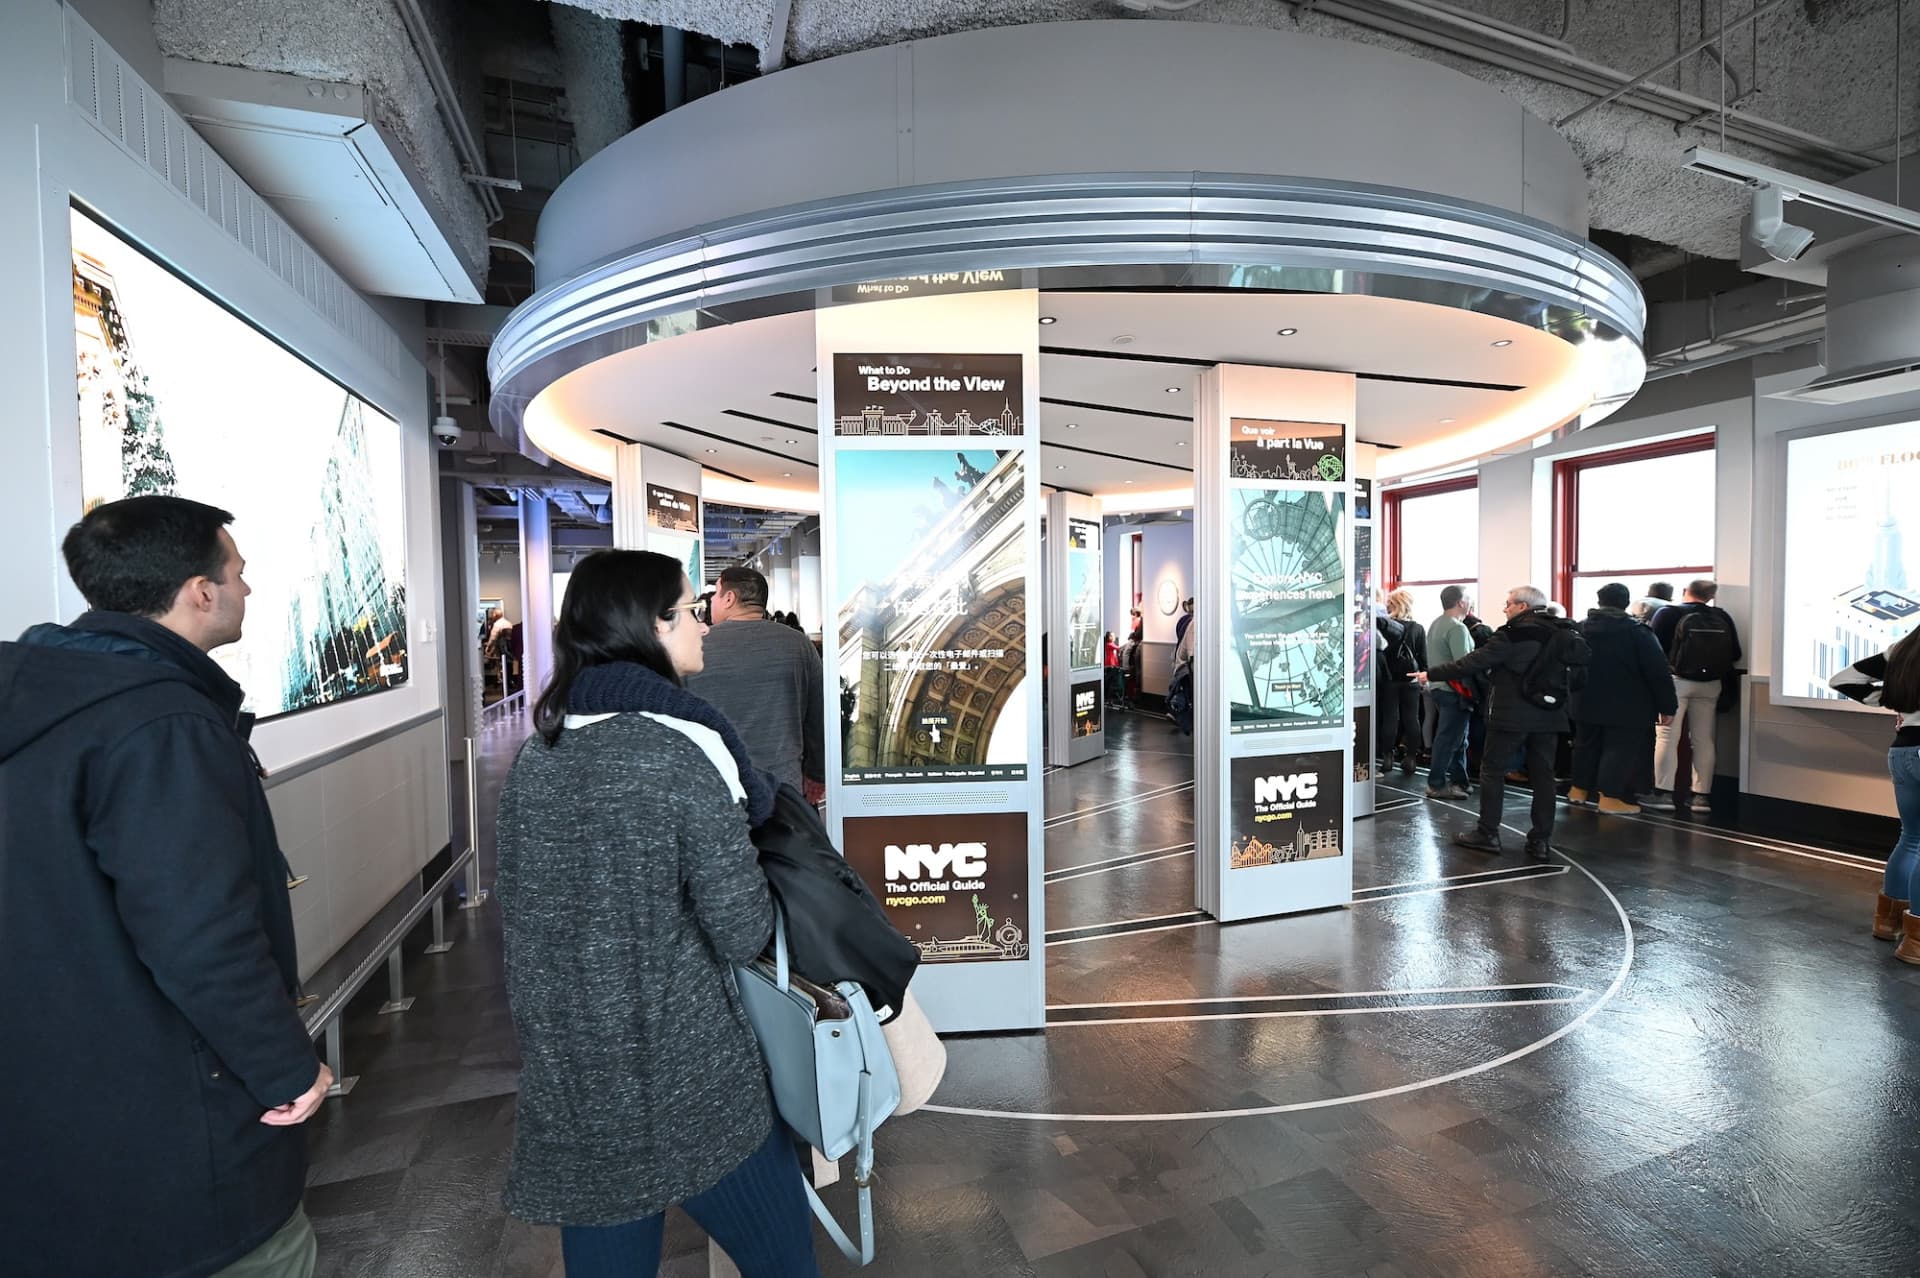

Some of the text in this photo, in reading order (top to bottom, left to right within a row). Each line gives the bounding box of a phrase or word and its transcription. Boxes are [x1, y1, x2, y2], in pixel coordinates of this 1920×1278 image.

[858, 366, 911, 375] What to Do
[867, 376, 1005, 394] Beyond the View
[1241, 425, 1259, 435] Que
[1266, 438, 1290, 450] part
[1292, 439, 1302, 449] la
[1302, 438, 1325, 450] Vue
[1308, 588, 1336, 599] here.
[1254, 773, 1318, 803] NYC
[1255, 800, 1317, 813] The Official Guide
[1254, 813, 1293, 823] nycgo.com
[884, 843, 987, 880] NYC
[885, 880, 986, 893] The Official Guide
[886, 895, 946, 907] nycgo.com
